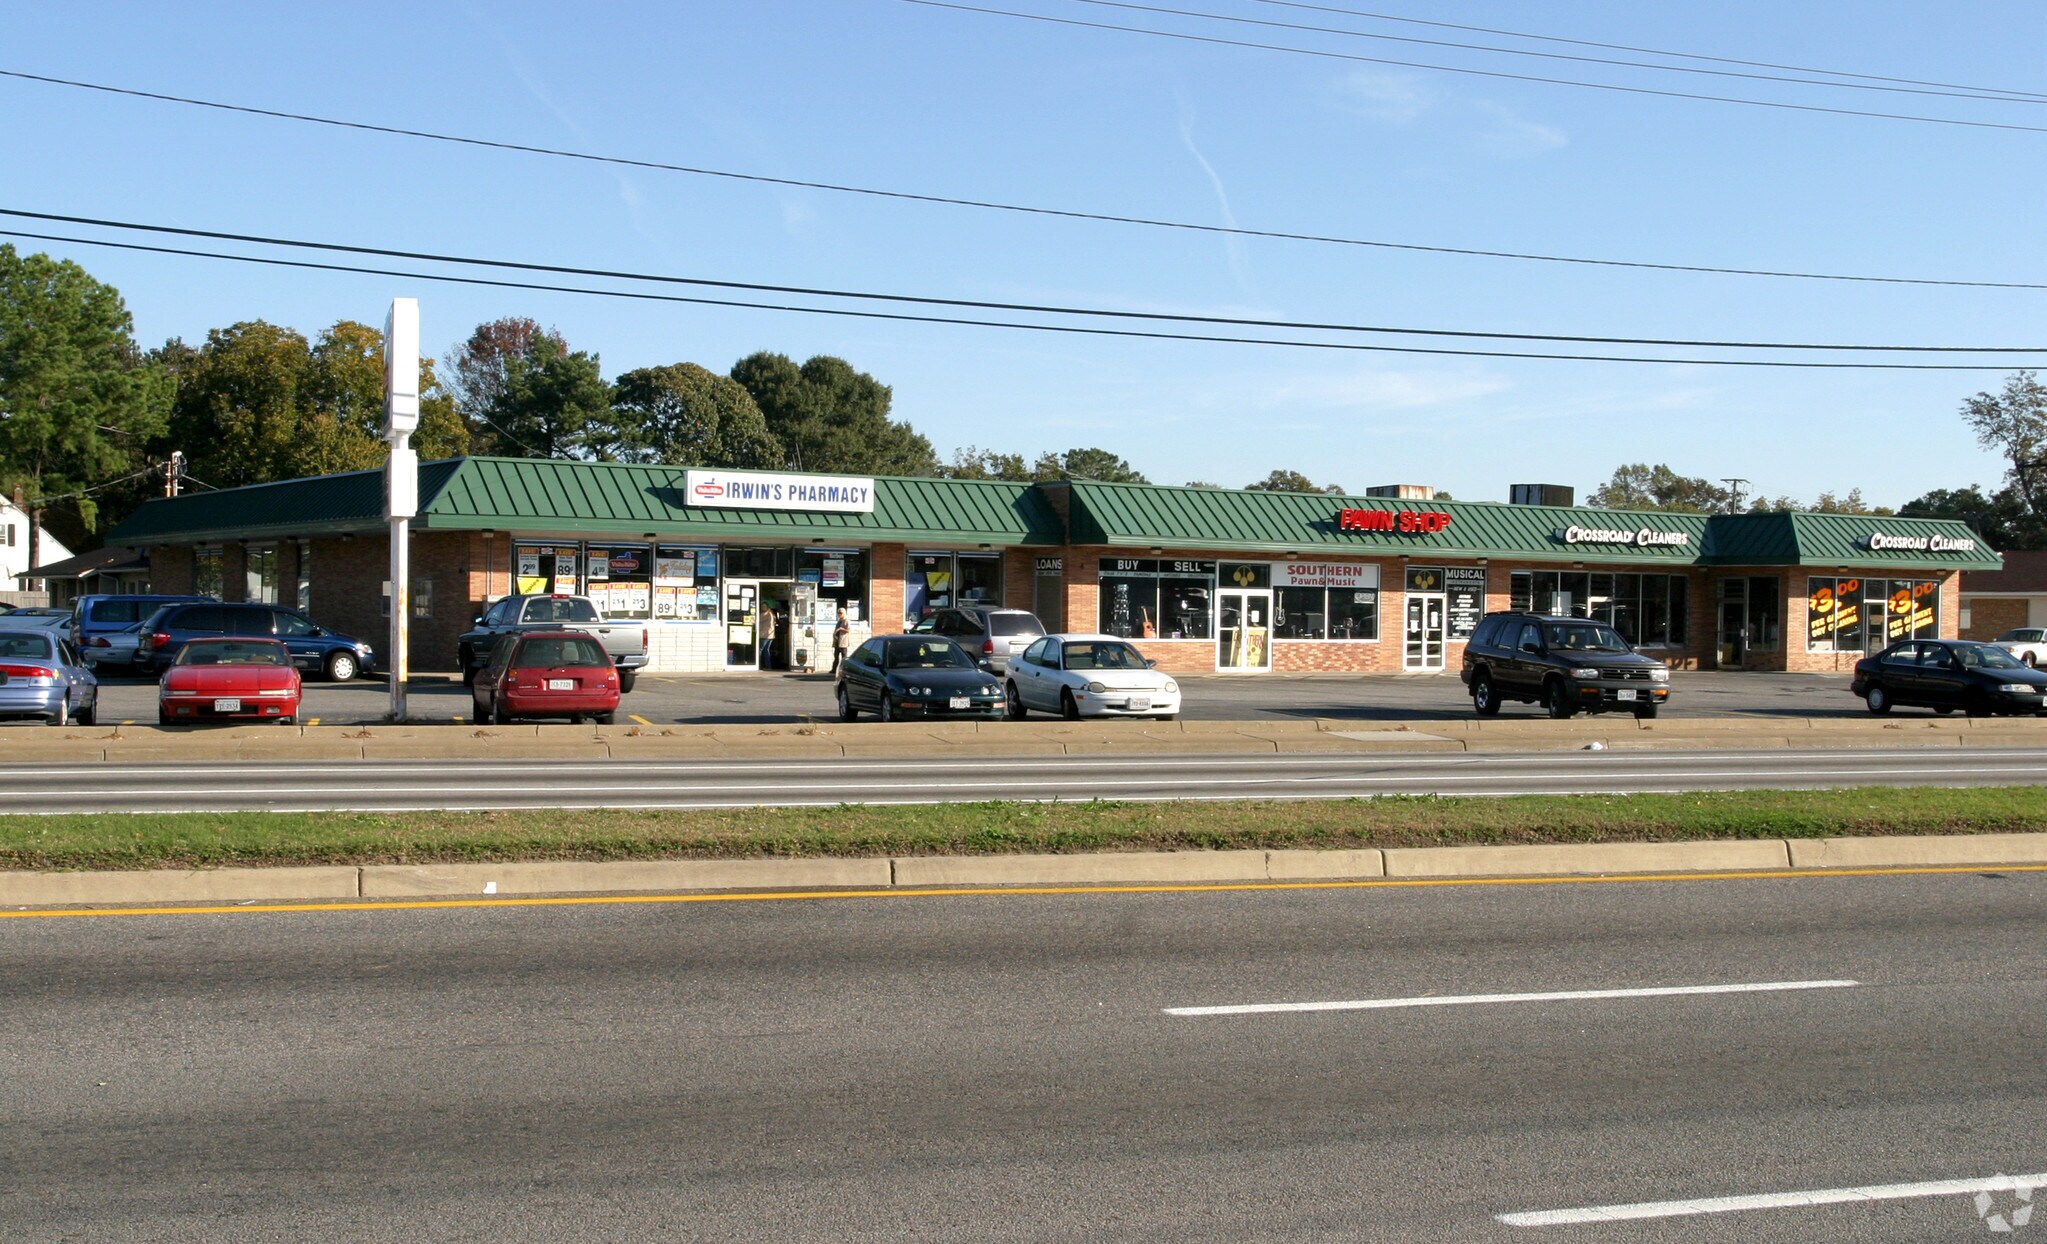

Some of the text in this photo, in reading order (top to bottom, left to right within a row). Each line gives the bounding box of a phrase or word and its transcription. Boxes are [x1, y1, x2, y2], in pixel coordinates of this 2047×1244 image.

[726, 482, 868, 503] IRWIN'S PHARMACY
[1340, 508, 1451, 532] PAWN SHOP
[1565, 525, 1688, 546] CROSSROAD CLEANERS
[1870, 532, 1975, 551] CROSSROAD CLEANERS
[1036, 559, 1062, 569] LOANS
[1117, 560, 1139, 570] BUY
[1174, 561, 1201, 572] SELL
[1287, 564, 1363, 577] SOUTHERN
[1446, 569, 1485, 579] MUSICAL
[1811, 617, 1826, 629] PER
[1889, 618, 1903, 630] PER
[1811, 626, 1827, 638] DRY
[1889, 627, 1904, 638] DRY
